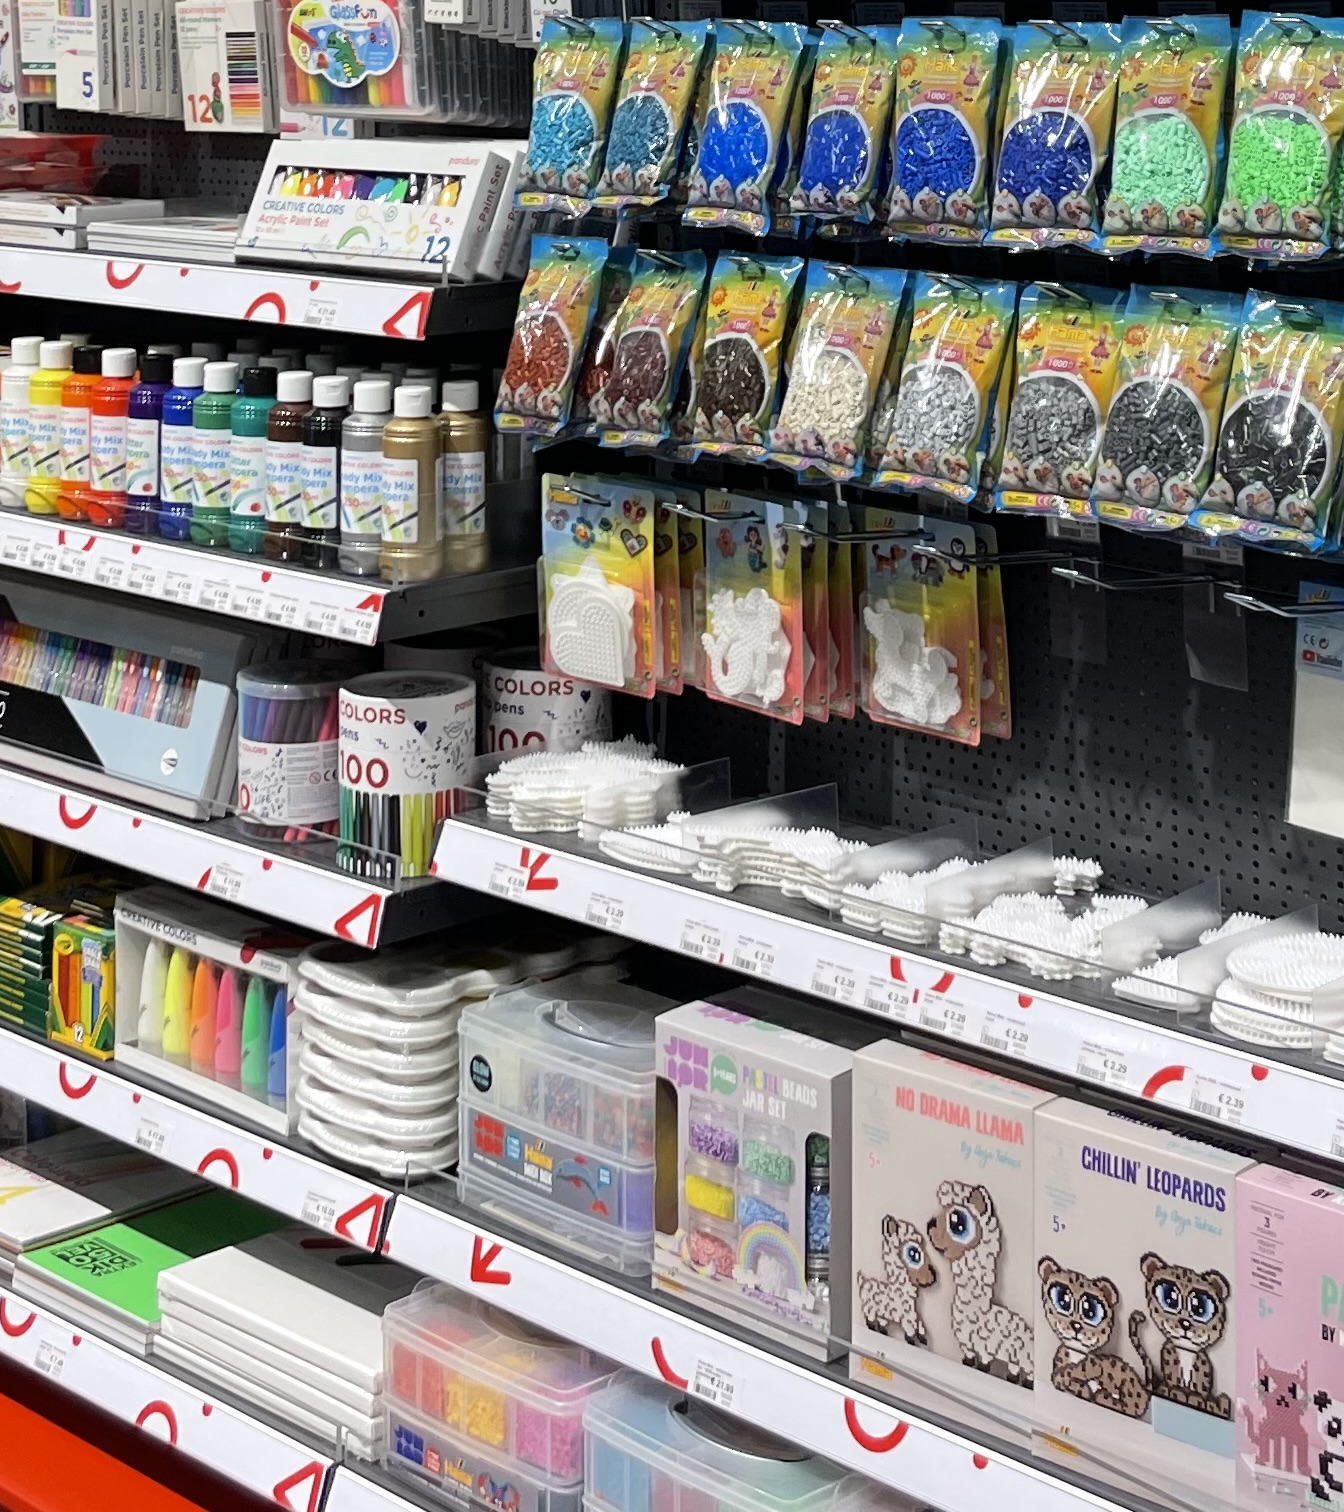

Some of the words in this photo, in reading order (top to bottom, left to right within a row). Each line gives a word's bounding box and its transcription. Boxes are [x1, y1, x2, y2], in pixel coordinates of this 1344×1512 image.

[82, 72, 93, 98] 5
[187, 94, 213, 124] 12
[258, 213, 288, 226] Acrylic
[290, 215, 313, 227] Paint
[315, 217, 330, 228] Set
[262, 200, 305, 213] CREATIVE
[307, 203, 346, 216] COLORS
[421, 235, 450, 264] 12
[494, 677, 574, 696] COLORS
[340, 700, 406, 725] COLORS
[494, 702, 525, 716] pens
[340, 749, 389, 789] 100
[119, 906, 161, 935] CREATIVE
[163, 923, 197, 946] COLORS
[73, 1023, 84, 1044] 12
[743, 1065, 779, 1094] PASTEL
[782, 1077, 818, 1108] BEADS
[742, 1094, 765, 1114] JAR
[768, 1099, 786, 1120] SET
[895, 1086, 915, 1109] NO
[919, 1092, 971, 1129] DRAMA
[976, 1108, 1025, 1146] LLAMA
[1081, 1145, 1141, 1184] CHILLIN'
[1146, 1167, 1227, 1212] LEOPARDS
[1321, 1325, 1336, 1343] BY
